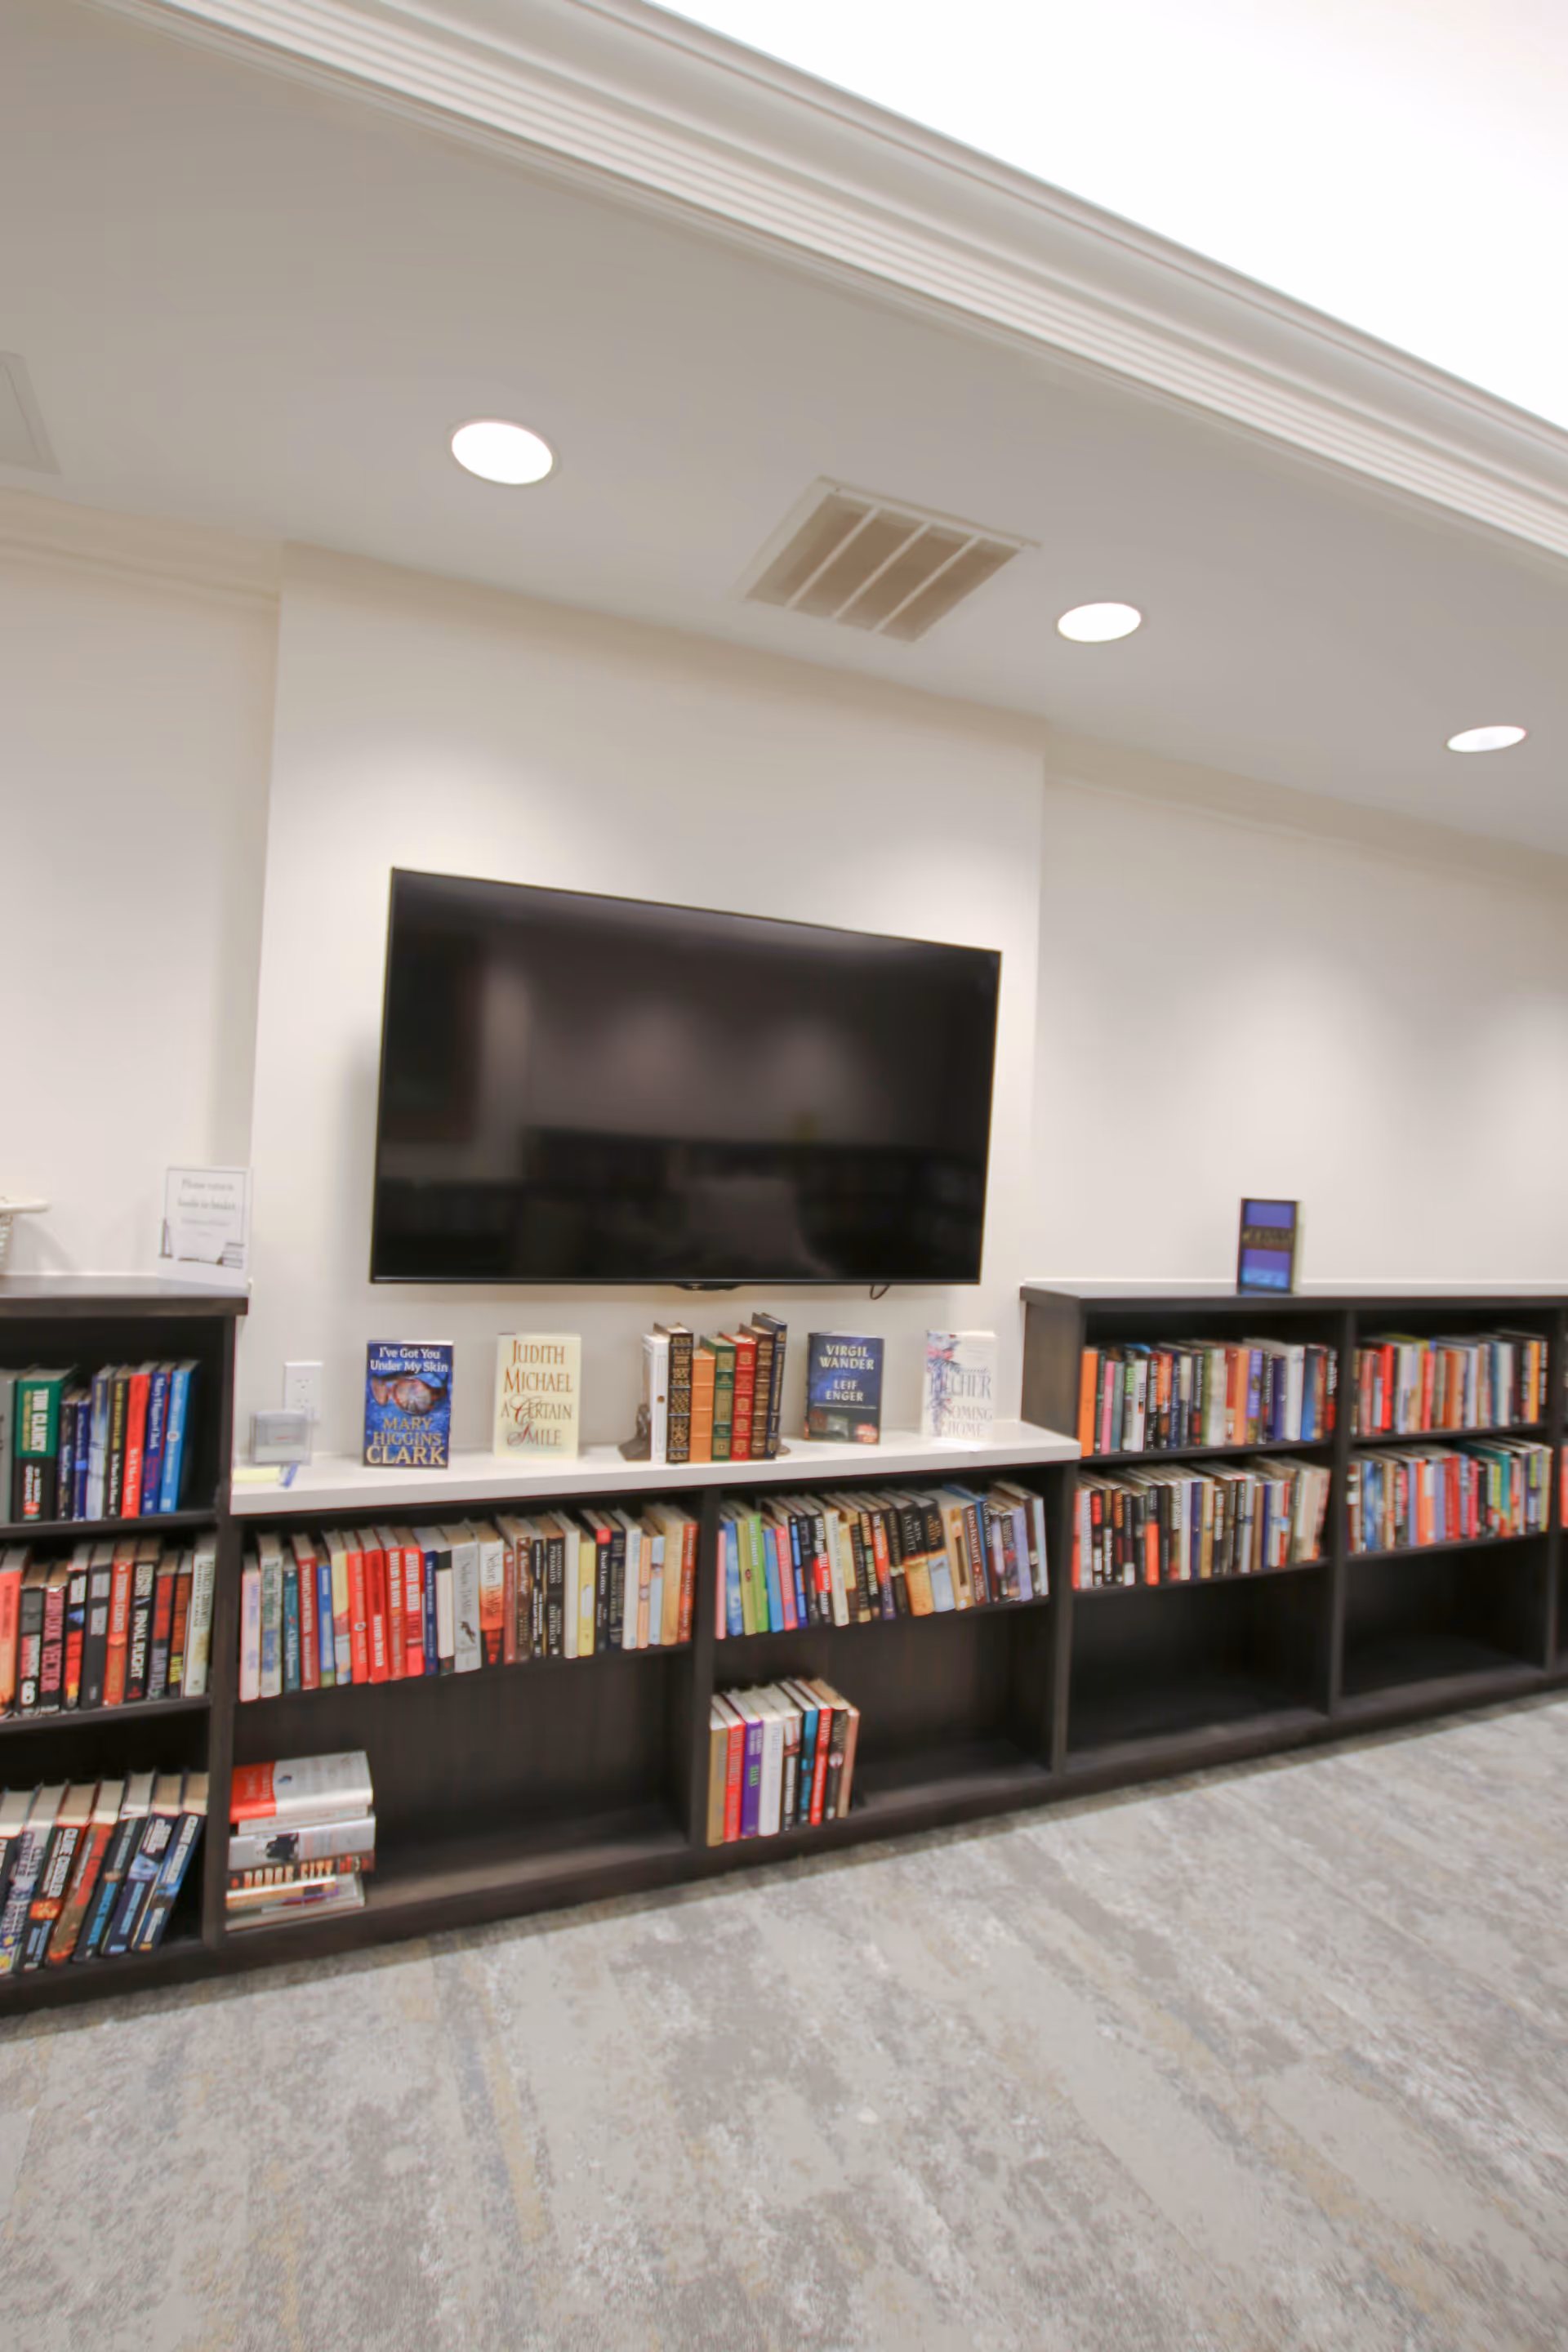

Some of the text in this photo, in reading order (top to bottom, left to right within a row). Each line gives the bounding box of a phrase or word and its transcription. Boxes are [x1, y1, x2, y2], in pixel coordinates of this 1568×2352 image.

[379, 1347, 440, 1360] I've Got You
[512, 1339, 565, 1365] JUDITH
[826, 1344, 869, 1358] VIRGIL
[369, 1360, 449, 1373] Under My Skin
[819, 1356, 875, 1370] WANDER
[504, 1366, 573, 1394] MICHAEL
[833, 1379, 858, 1390] LEIF
[826, 1390, 864, 1402] ENGER
[501, 1401, 510, 1419] A
[30, 1412, 48, 1452] CLANCY
[384, 1417, 433, 1431] MARY
[506, 1421, 563, 1448] SMILE
[373, 1432, 442, 1446] HIGGINS
[366, 1446, 446, 1466] CLARK
[814, 1518, 829, 1569] CATCH AND KILL
[967, 1509, 980, 1565] KEN FOLLETT
[599, 1571, 608, 1596] Letters
[819, 1591, 829, 1615] FARROW
[549, 1606, 557, 1645] DIETRICH
[130, 1609, 149, 1679] FINAL FLIGHT
